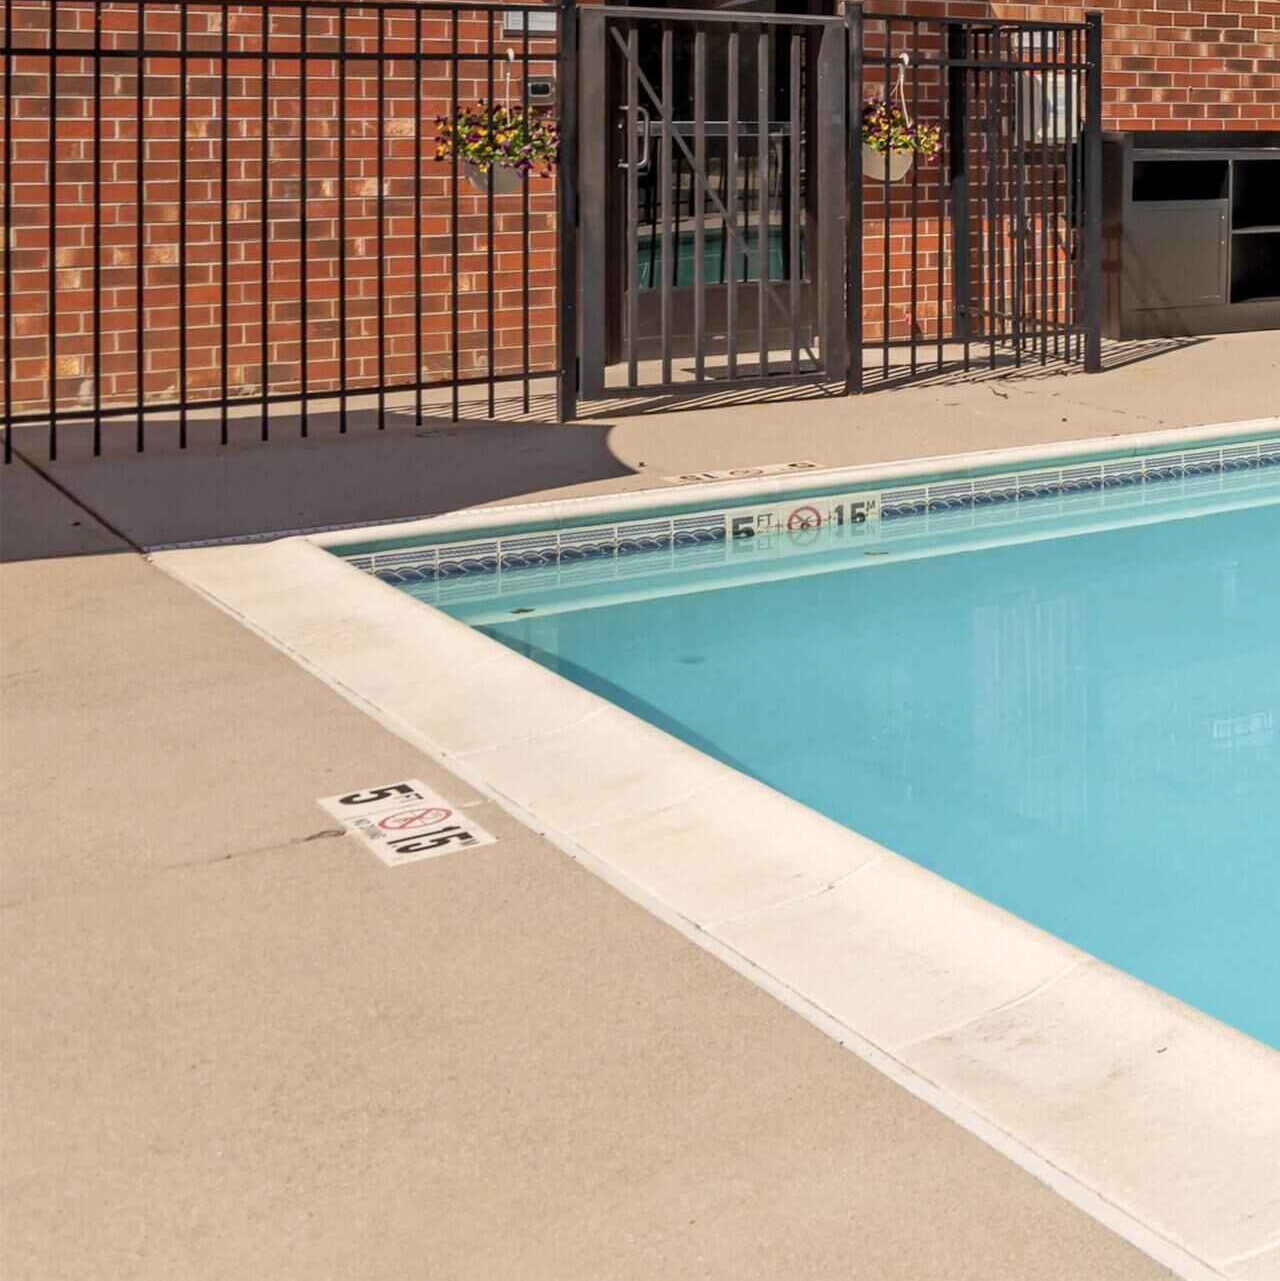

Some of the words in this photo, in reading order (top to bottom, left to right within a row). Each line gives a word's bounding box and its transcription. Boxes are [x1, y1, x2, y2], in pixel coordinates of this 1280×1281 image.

[732, 516, 755, 539] 5
[757, 513, 773, 527] FT
[866, 500, 876, 511] M
[339, 784, 414, 805] 5
